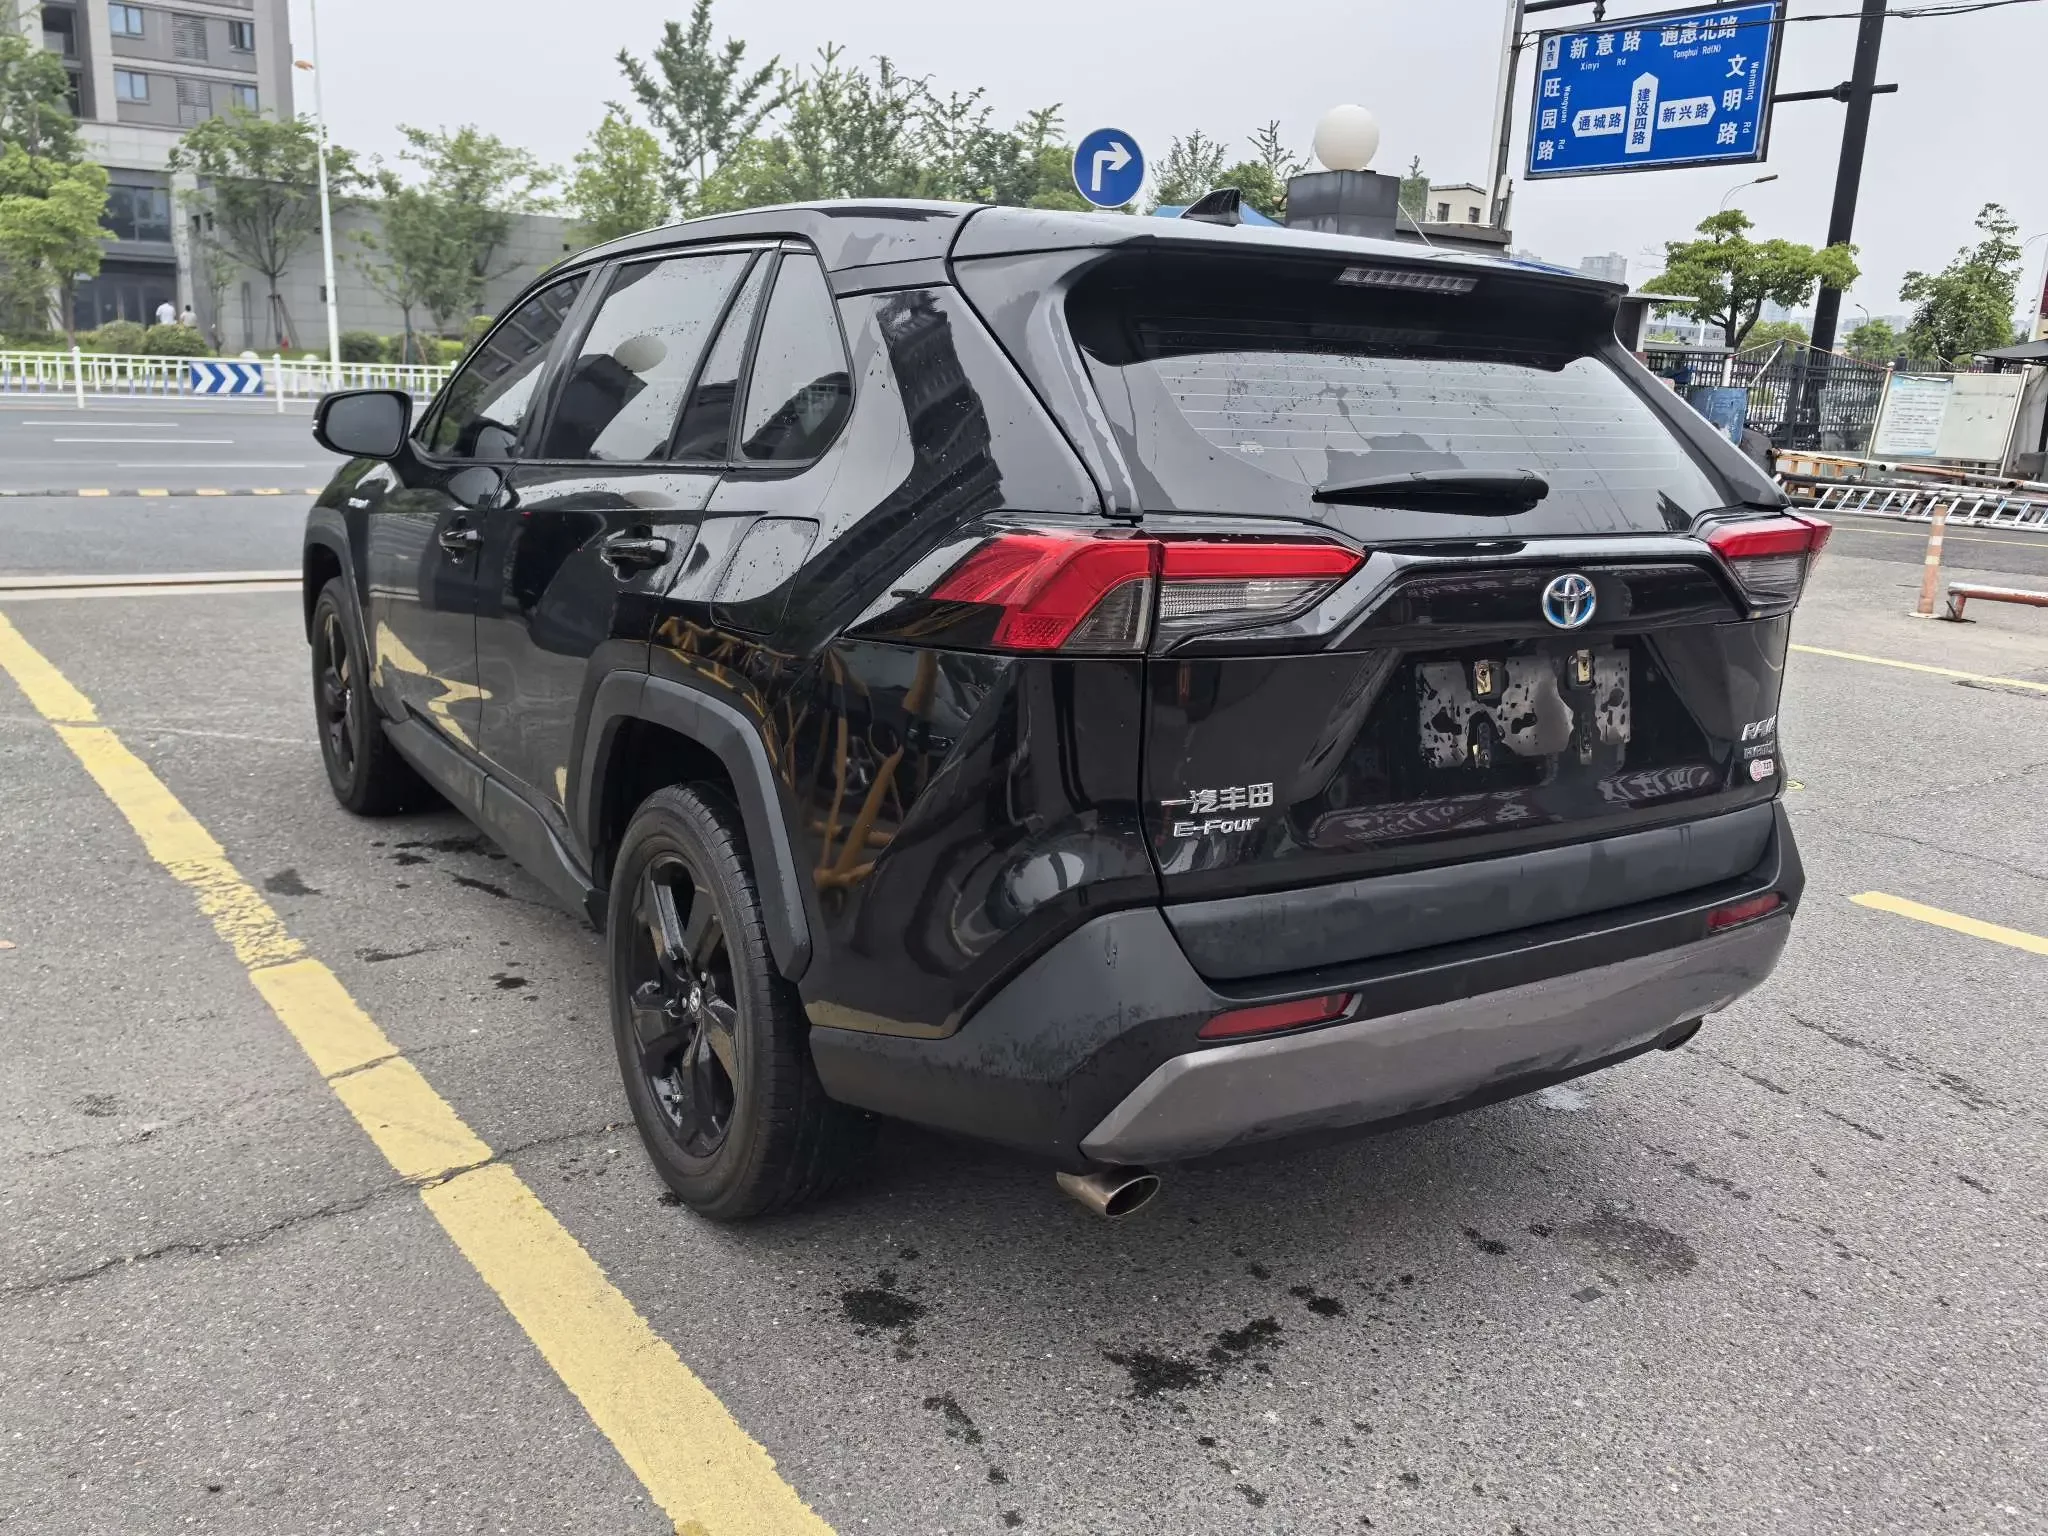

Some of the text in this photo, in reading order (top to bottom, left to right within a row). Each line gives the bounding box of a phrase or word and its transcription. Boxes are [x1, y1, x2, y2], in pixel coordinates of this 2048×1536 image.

[1570, 31, 1641, 59] 新意路
[1660, 16, 1738, 46] 通惠北路
[1580, 58, 1626, 71] Xinyi Rd
[1717, 54, 1747, 144] 文明路
[1743, 61, 1759, 133] Wenming Rd
[1537, 77, 1561, 160] 旺园路
[1558, 85, 1571, 149] Wangyuan Rd
[1578, 112, 1621, 131] 通城路
[1632, 88, 1651, 144] 建设四路
[1661, 103, 1710, 122] 新兴路
[1741, 715, 1777, 741] RAV
[1161, 783, 1273, 814] 一汽丰田
[1173, 817, 1260, 837] E-Four
